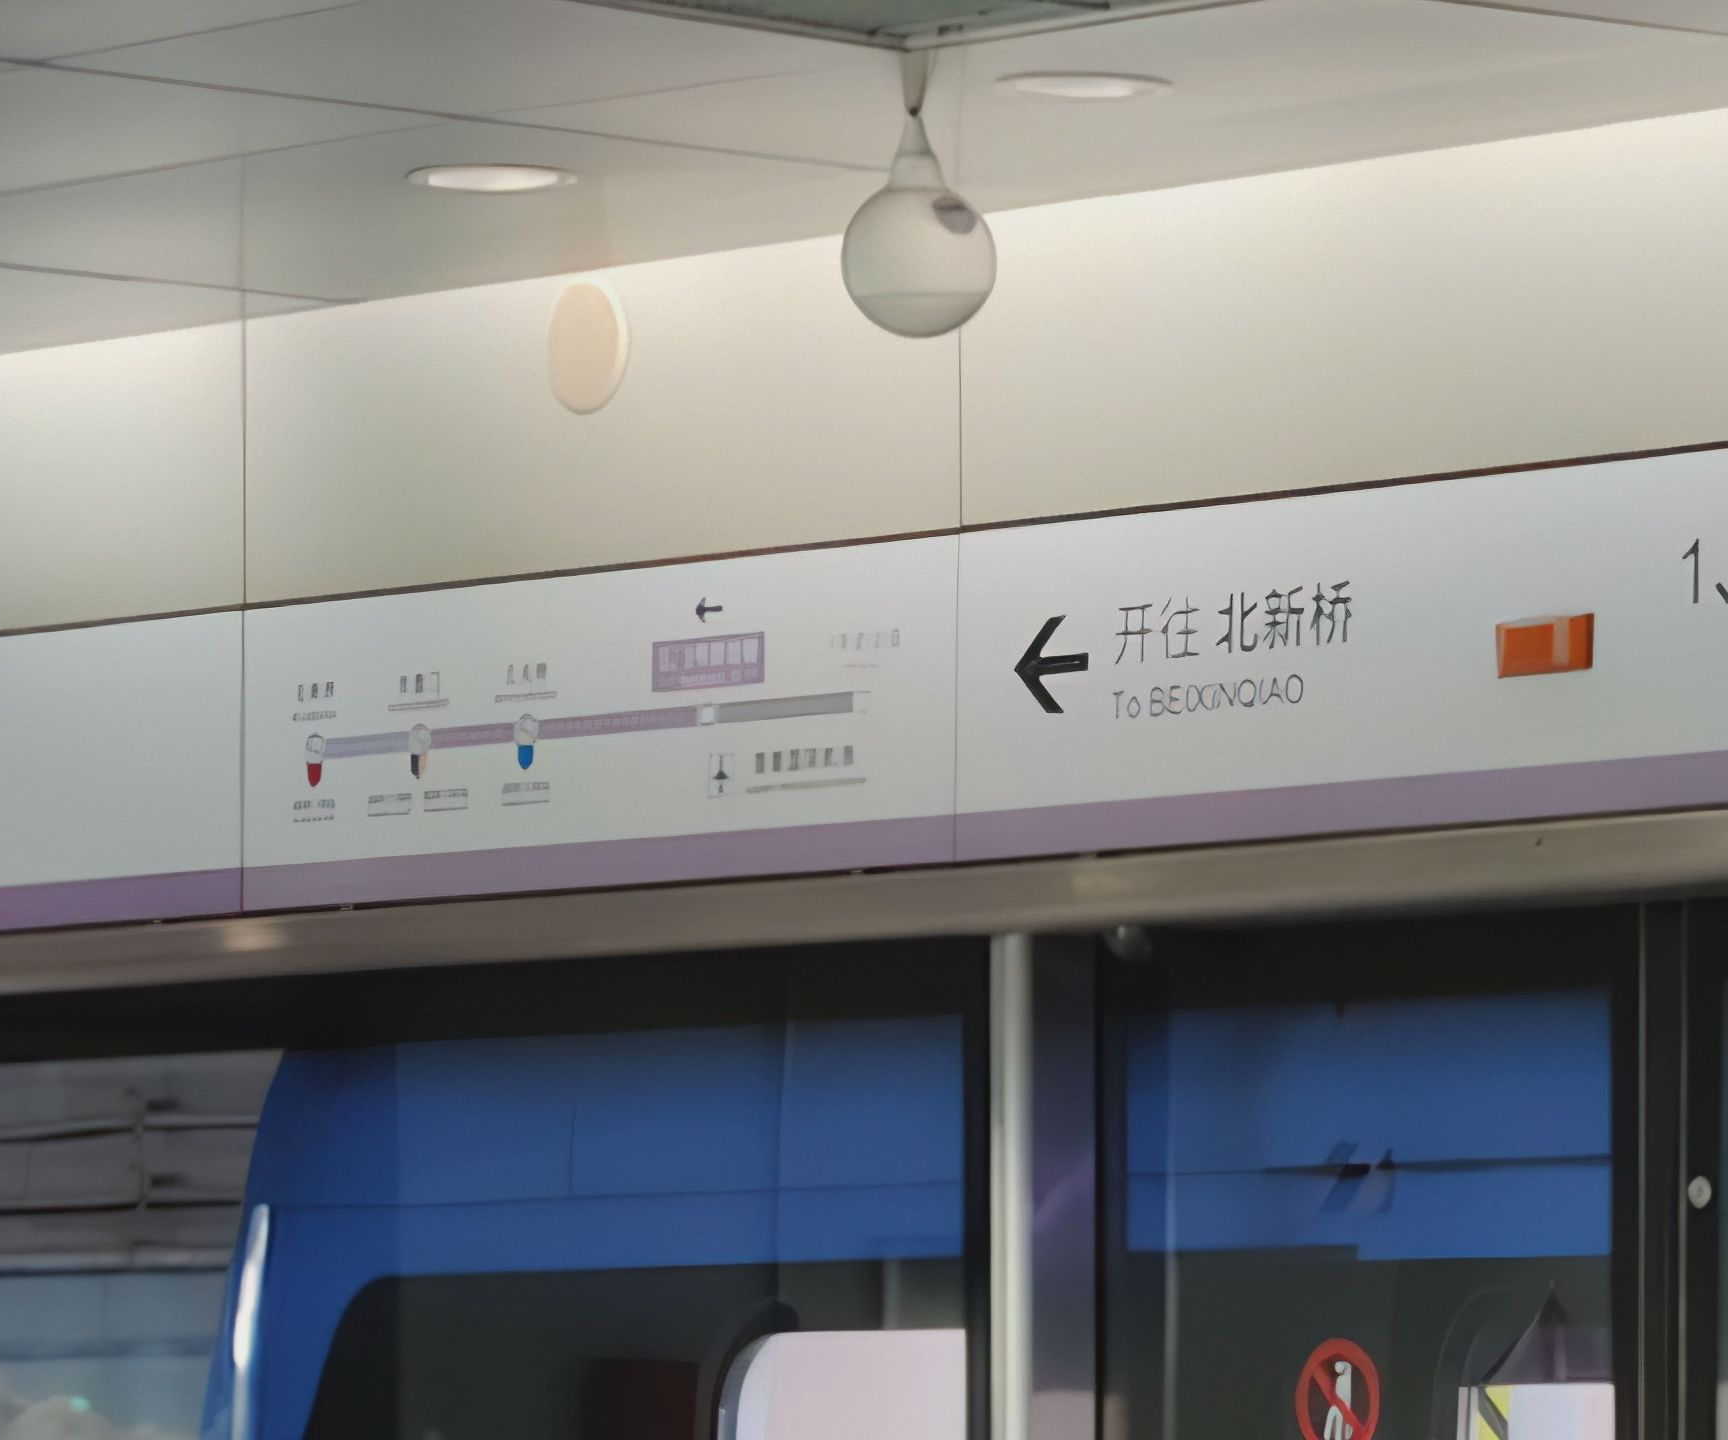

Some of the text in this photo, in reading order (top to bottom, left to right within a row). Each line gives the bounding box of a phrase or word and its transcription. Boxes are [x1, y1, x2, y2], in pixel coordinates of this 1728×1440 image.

[1114, 580, 1353, 666] 开往 北新桥
[1112, 689, 1142, 719] To
